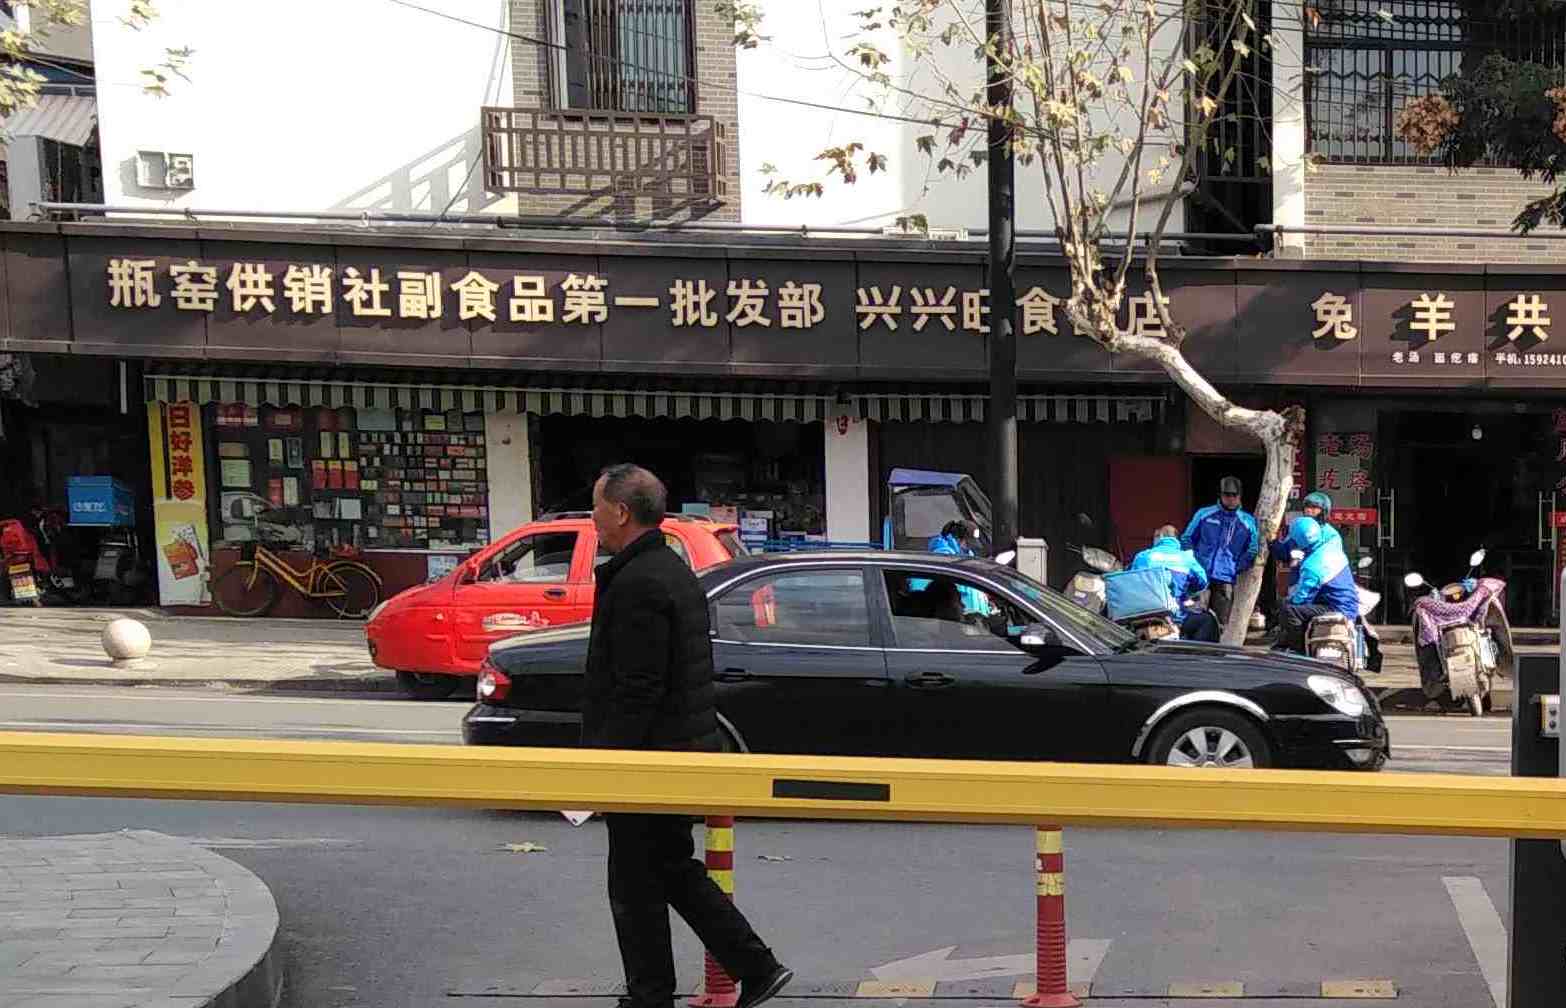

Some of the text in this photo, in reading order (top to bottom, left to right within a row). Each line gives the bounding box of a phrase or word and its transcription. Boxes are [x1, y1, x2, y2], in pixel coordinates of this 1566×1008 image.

[107, 257, 825, 328] 瓶窑供销社副食品第一批发部
[855, 285, 1170, 338] 兴兴旺食店
